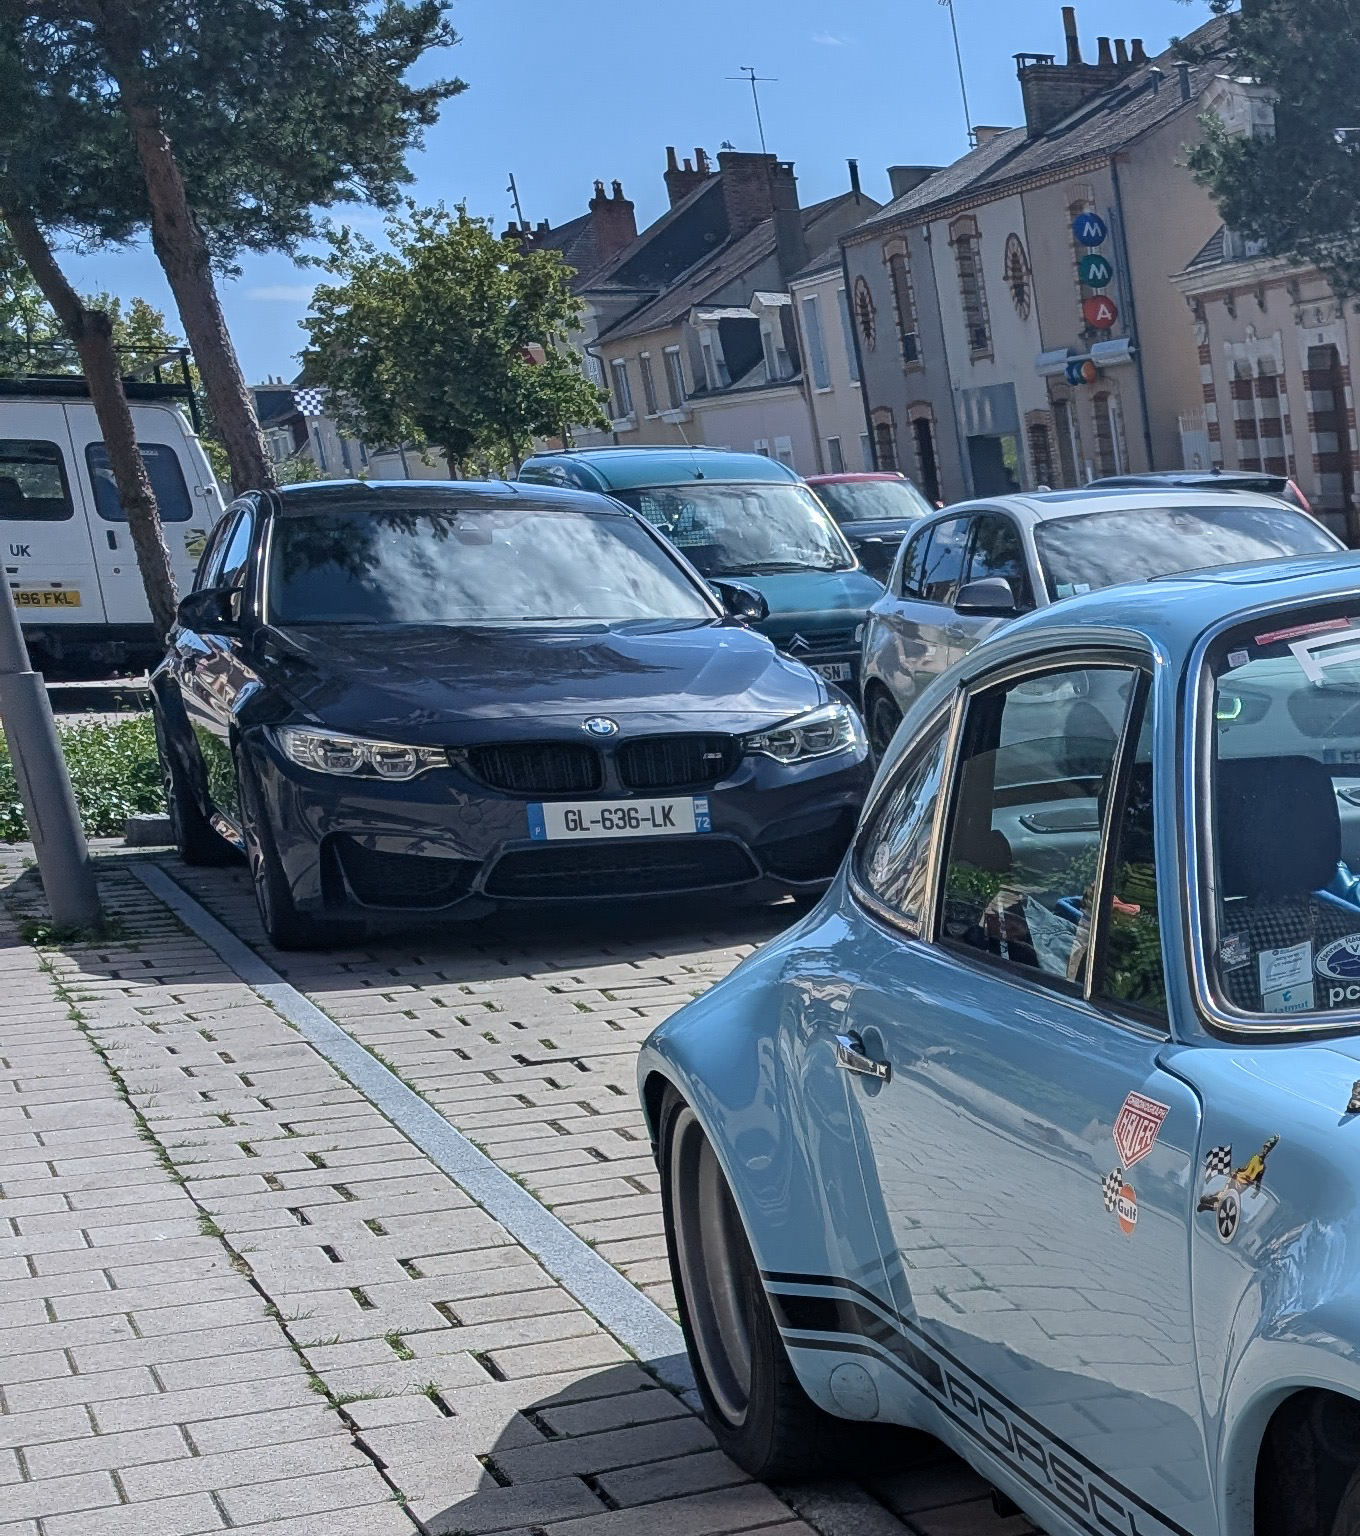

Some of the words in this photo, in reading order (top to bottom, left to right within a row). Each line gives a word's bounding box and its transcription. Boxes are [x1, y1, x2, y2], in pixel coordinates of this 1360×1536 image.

[9, 543, 32, 558] UK
[43, 592, 74, 605] FKL
[563, 804, 676, 832] GL-636-LK
[695, 816, 710, 829] 72
[1117, 1198, 1137, 1221] Gulf
